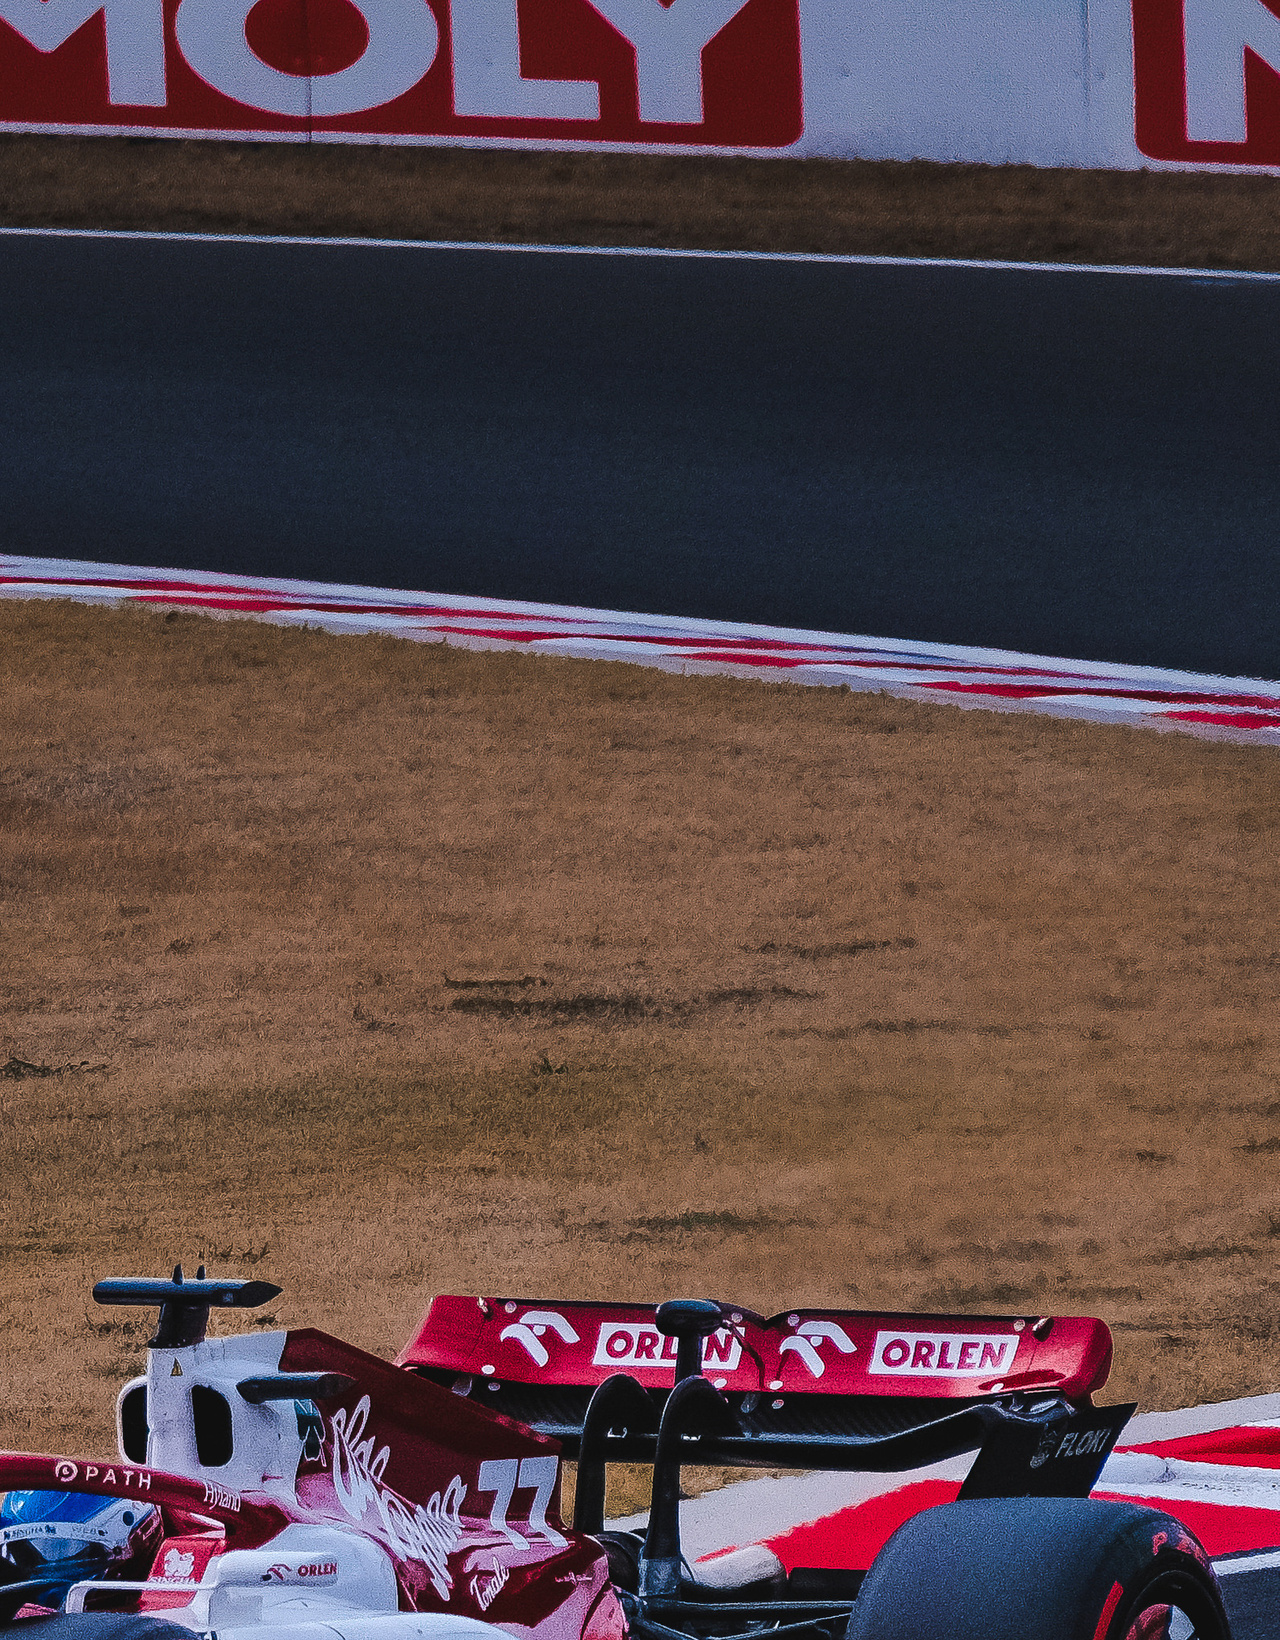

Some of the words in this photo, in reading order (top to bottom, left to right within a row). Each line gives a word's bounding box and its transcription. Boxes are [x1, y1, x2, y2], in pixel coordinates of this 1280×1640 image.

[605, 1329, 734, 1363] ORLN
[882, 1339, 1009, 1370] ORLEN
[1055, 1428, 1112, 1458] FLOKI
[86, 1465, 153, 1491] PATH
[477, 1455, 570, 1551] 77
[297, 1562, 338, 1577] ORLEN
